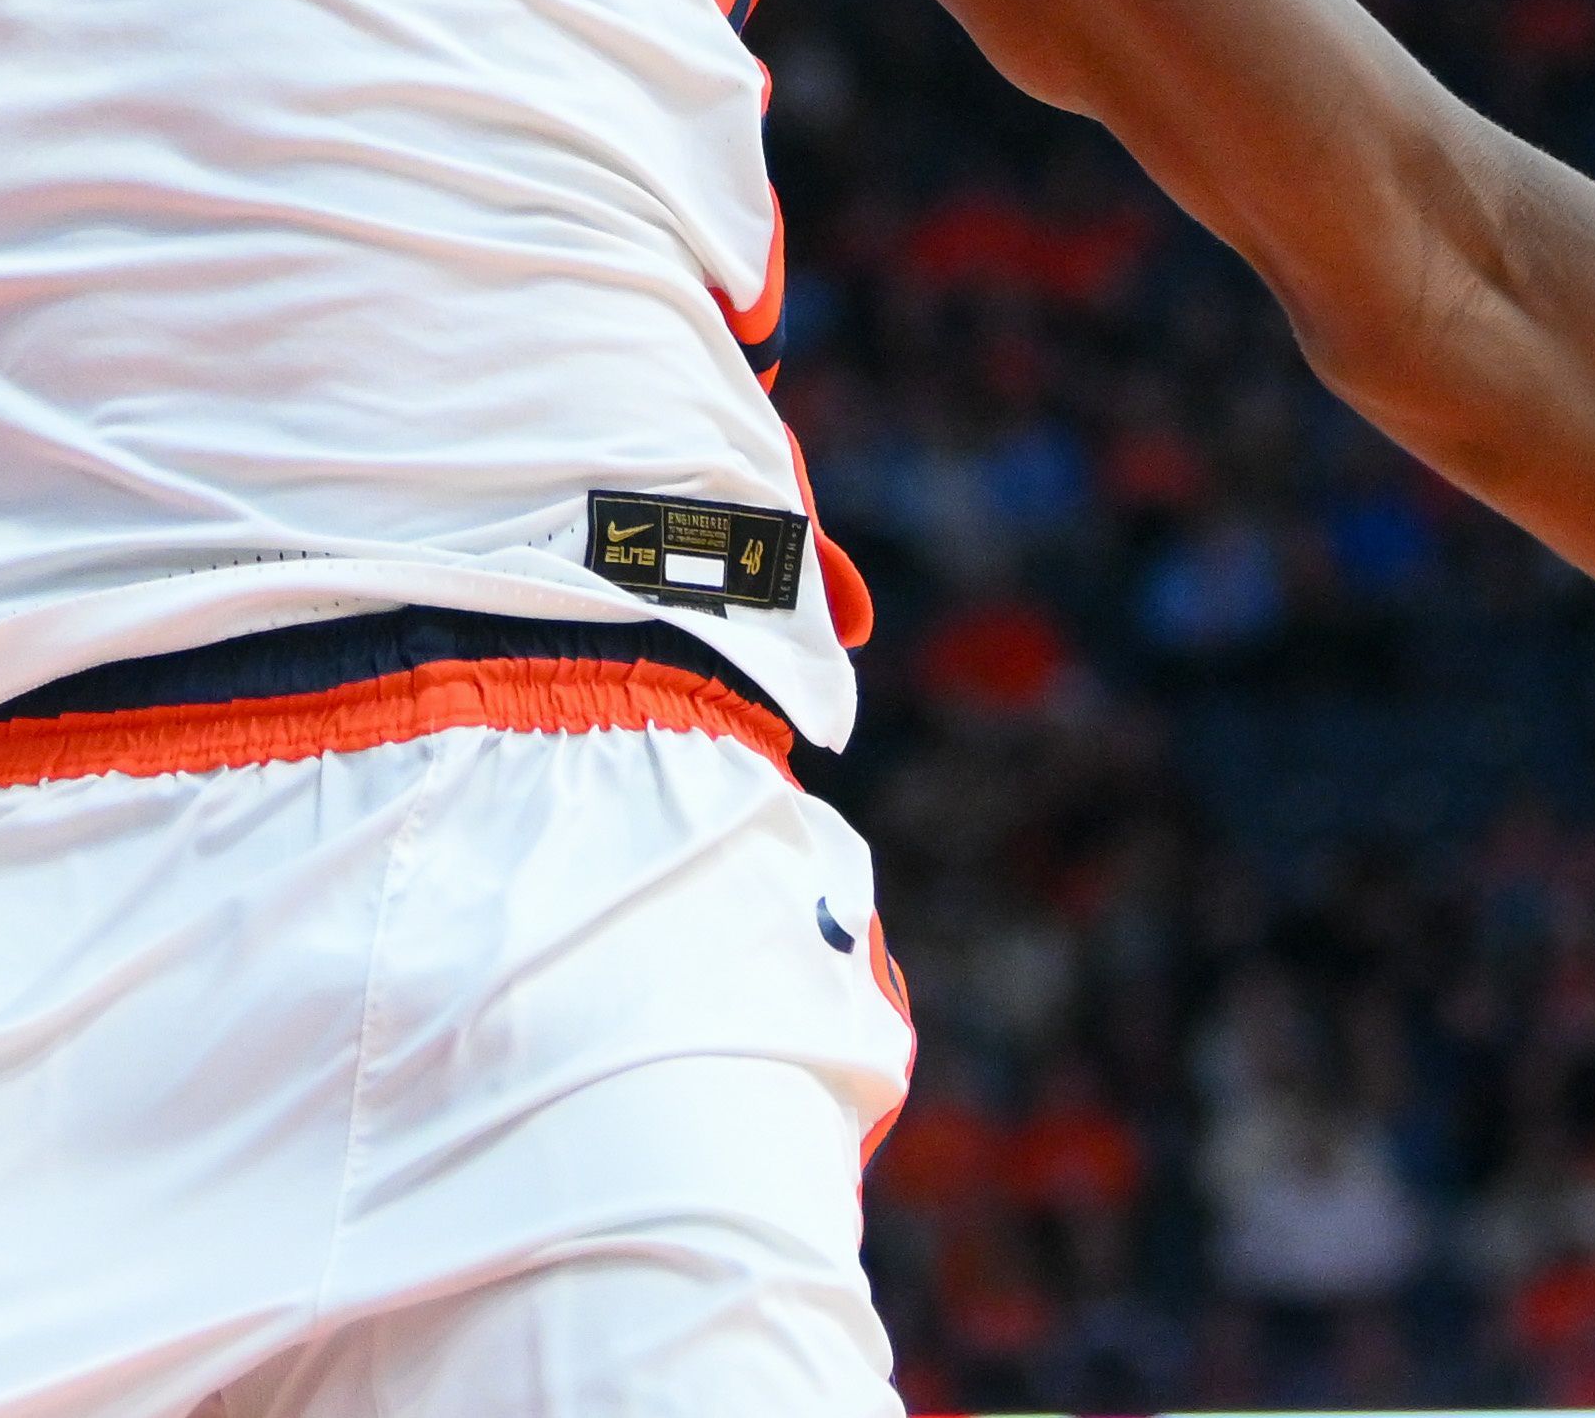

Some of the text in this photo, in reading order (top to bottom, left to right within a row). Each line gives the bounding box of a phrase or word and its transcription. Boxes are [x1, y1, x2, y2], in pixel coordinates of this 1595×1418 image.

[667, 511, 730, 531] ENGINEERED
[604, 545, 656, 566] ELITE
[739, 538, 764, 576] 48
[778, 542, 797, 602] LENGTH
